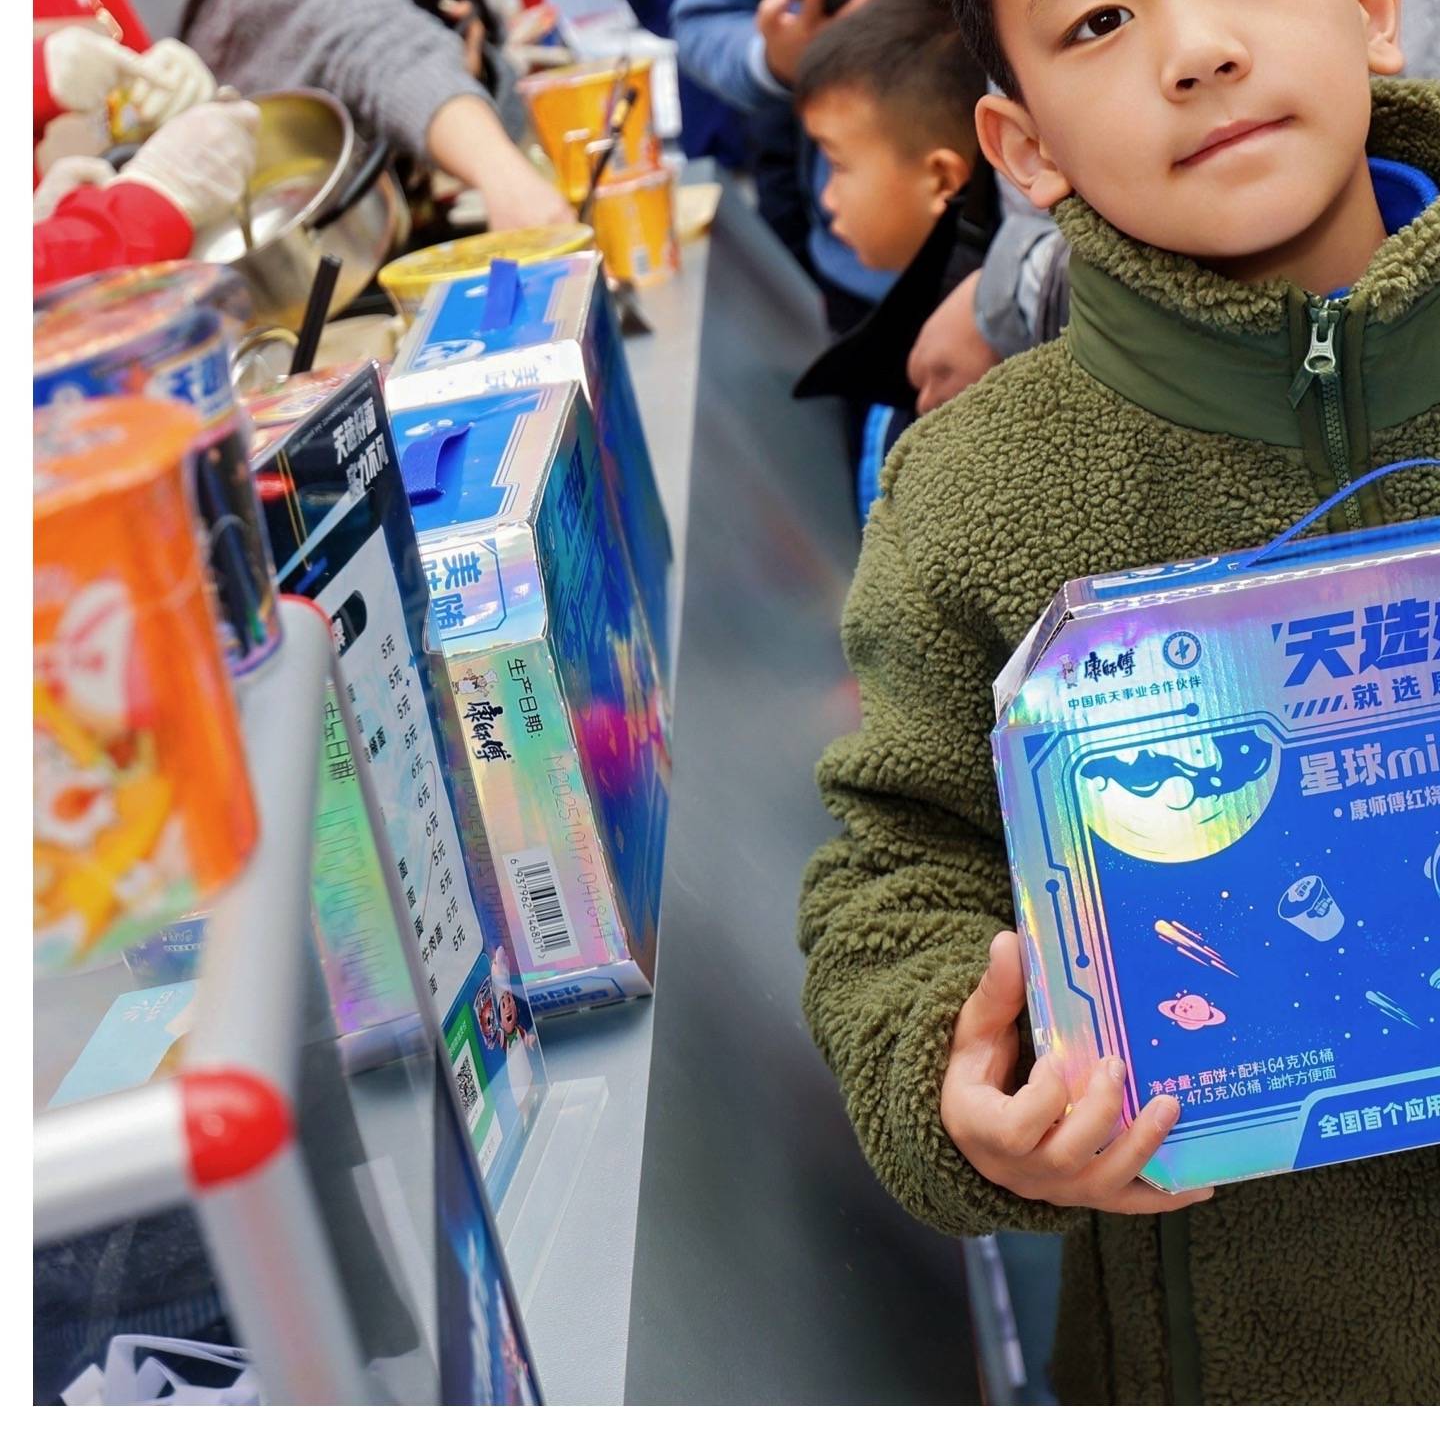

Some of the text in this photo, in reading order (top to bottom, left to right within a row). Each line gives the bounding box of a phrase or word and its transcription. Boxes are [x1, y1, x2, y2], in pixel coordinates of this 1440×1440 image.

[381, 634, 396, 660] 5元
[388, 664, 404, 690] 5元
[1084, 648, 1136, 683] 康師傅
[507, 658, 543, 739] 生产日期:
[1068, 675, 1202, 710] 中国航天事业合作伙伴
[396, 694, 411, 720] 5元
[404, 724, 418, 750] 5元
[464, 701, 512, 763] 康師傅
[440, 868, 453, 895] 5元
[446, 897, 459, 924] 5元
[453, 925, 466, 952] 5元
[1175, 1065, 1336, 1107] :47.5克X6桶 油炸方便面
